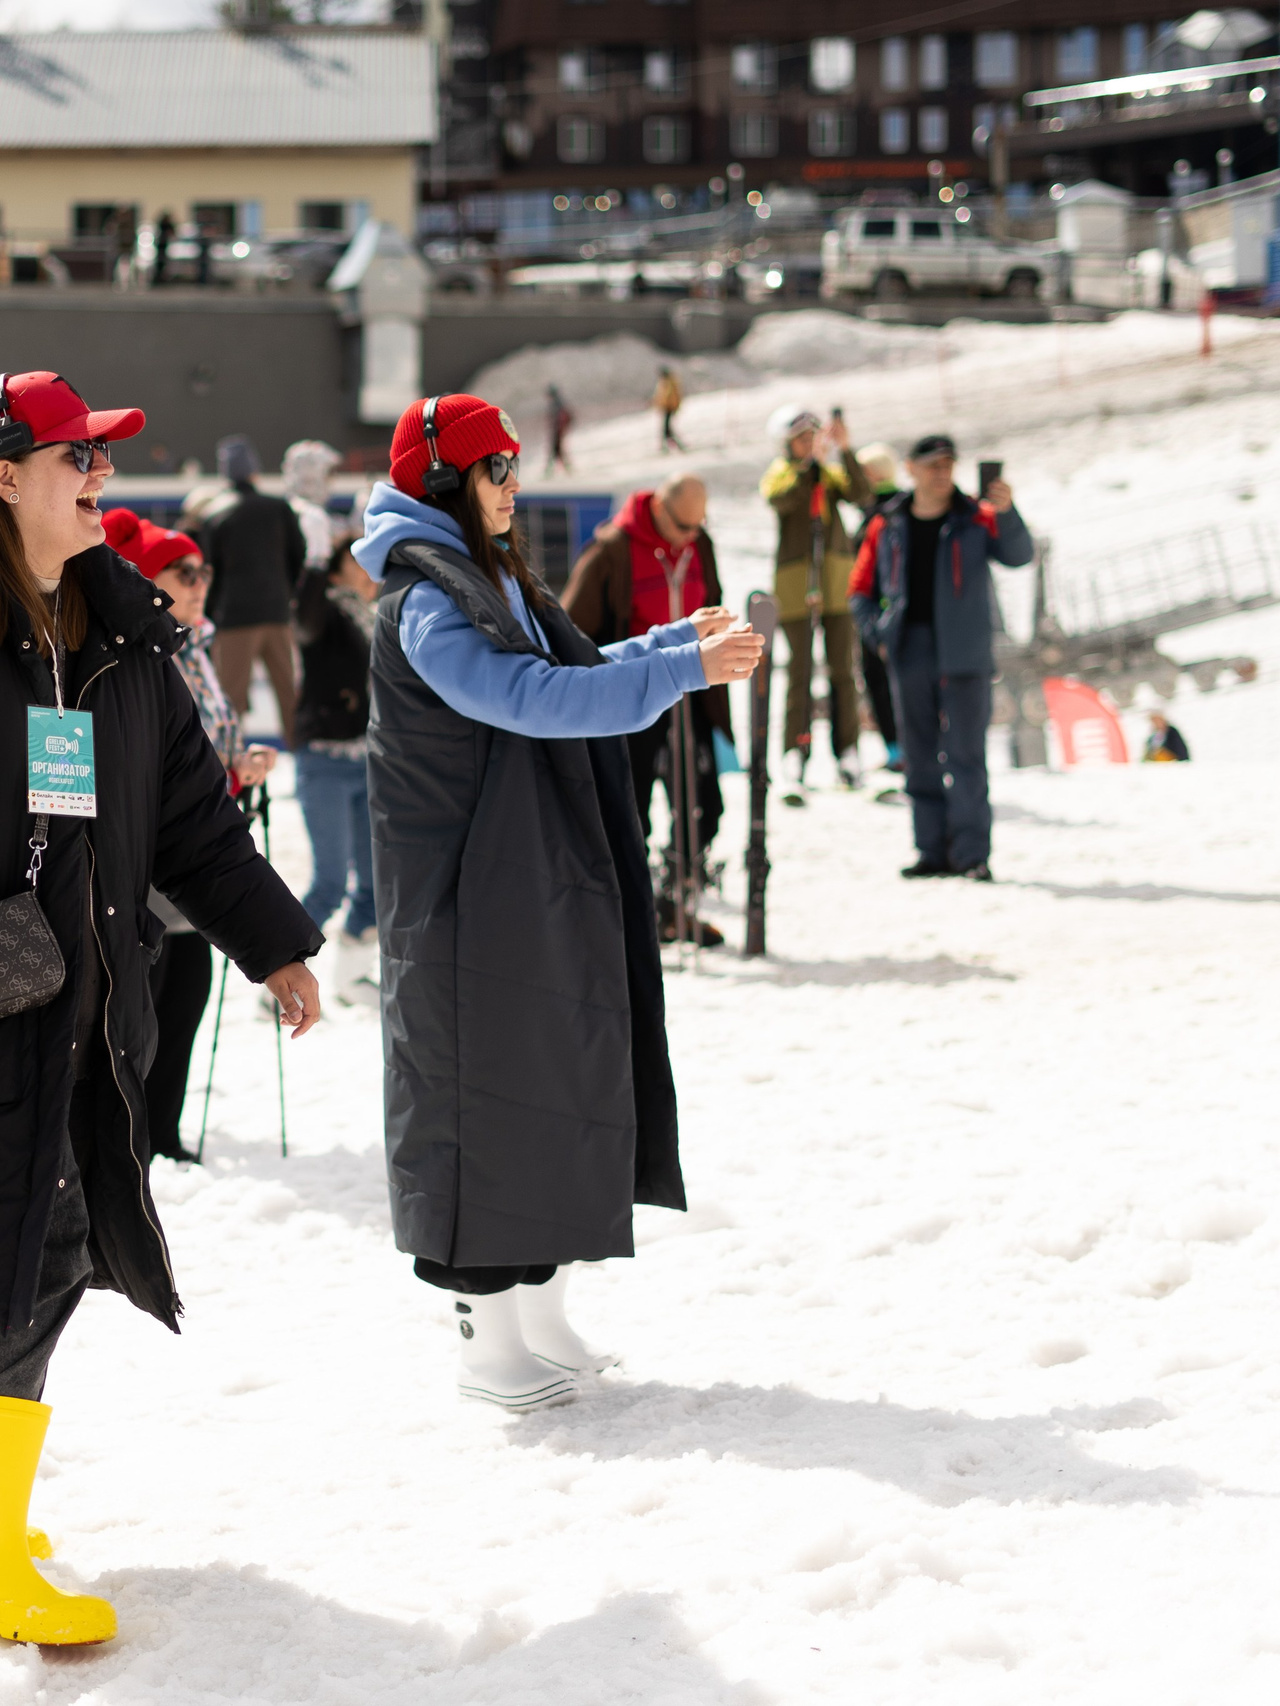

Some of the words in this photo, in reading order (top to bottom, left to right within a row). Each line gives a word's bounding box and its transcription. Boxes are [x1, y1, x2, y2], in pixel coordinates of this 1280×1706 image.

[0, 417, 6, 426] 7
[433, 461, 440, 470] 2
[32, 761, 91, 777] ОРГАНИЗАТОР
